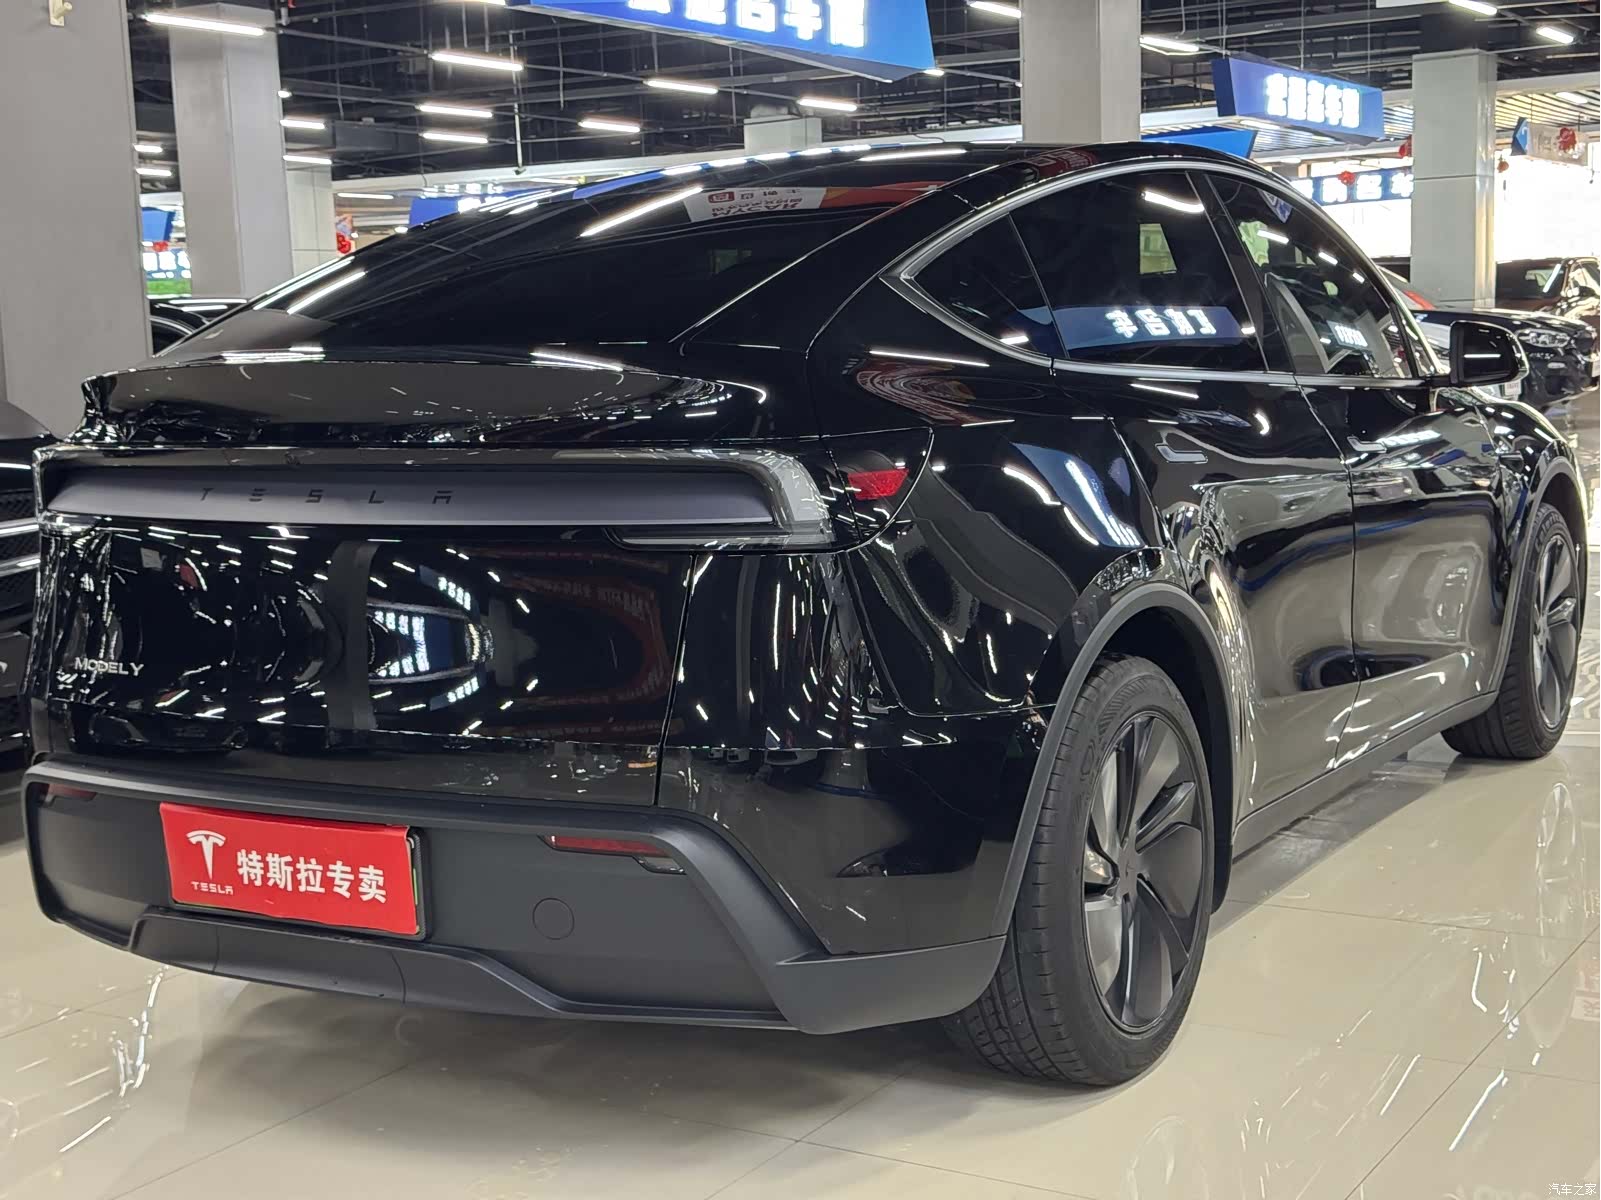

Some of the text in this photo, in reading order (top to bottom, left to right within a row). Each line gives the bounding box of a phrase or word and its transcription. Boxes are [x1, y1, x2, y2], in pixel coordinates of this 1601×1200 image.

[200, 487, 454, 505] TESLA
[237, 848, 387, 904] 特斯拉专卖
[191, 880, 234, 896] TESLA
